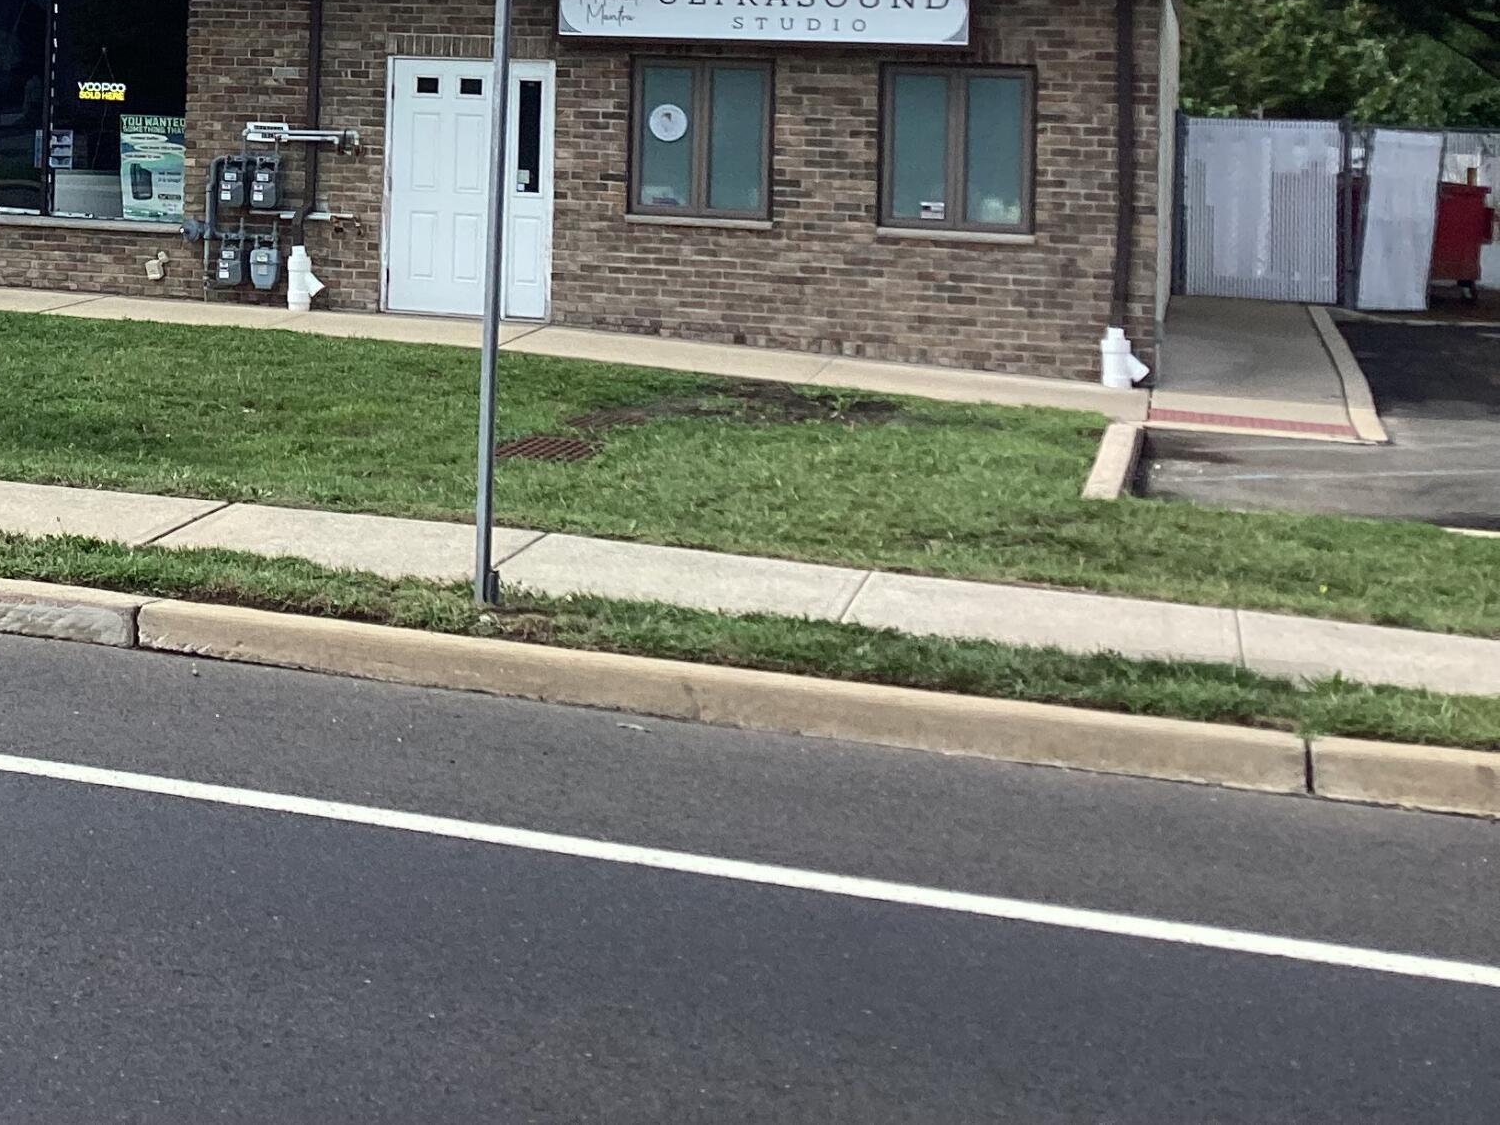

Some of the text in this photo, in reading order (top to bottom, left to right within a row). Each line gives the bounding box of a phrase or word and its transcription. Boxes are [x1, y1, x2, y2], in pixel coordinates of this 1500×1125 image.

[732, 17, 867, 32] STUDIO
[79, 91, 125, 100] SOLD HERE
[121, 117, 185, 127] YOU WANTED
[123, 125, 166, 133] SOMETHING
